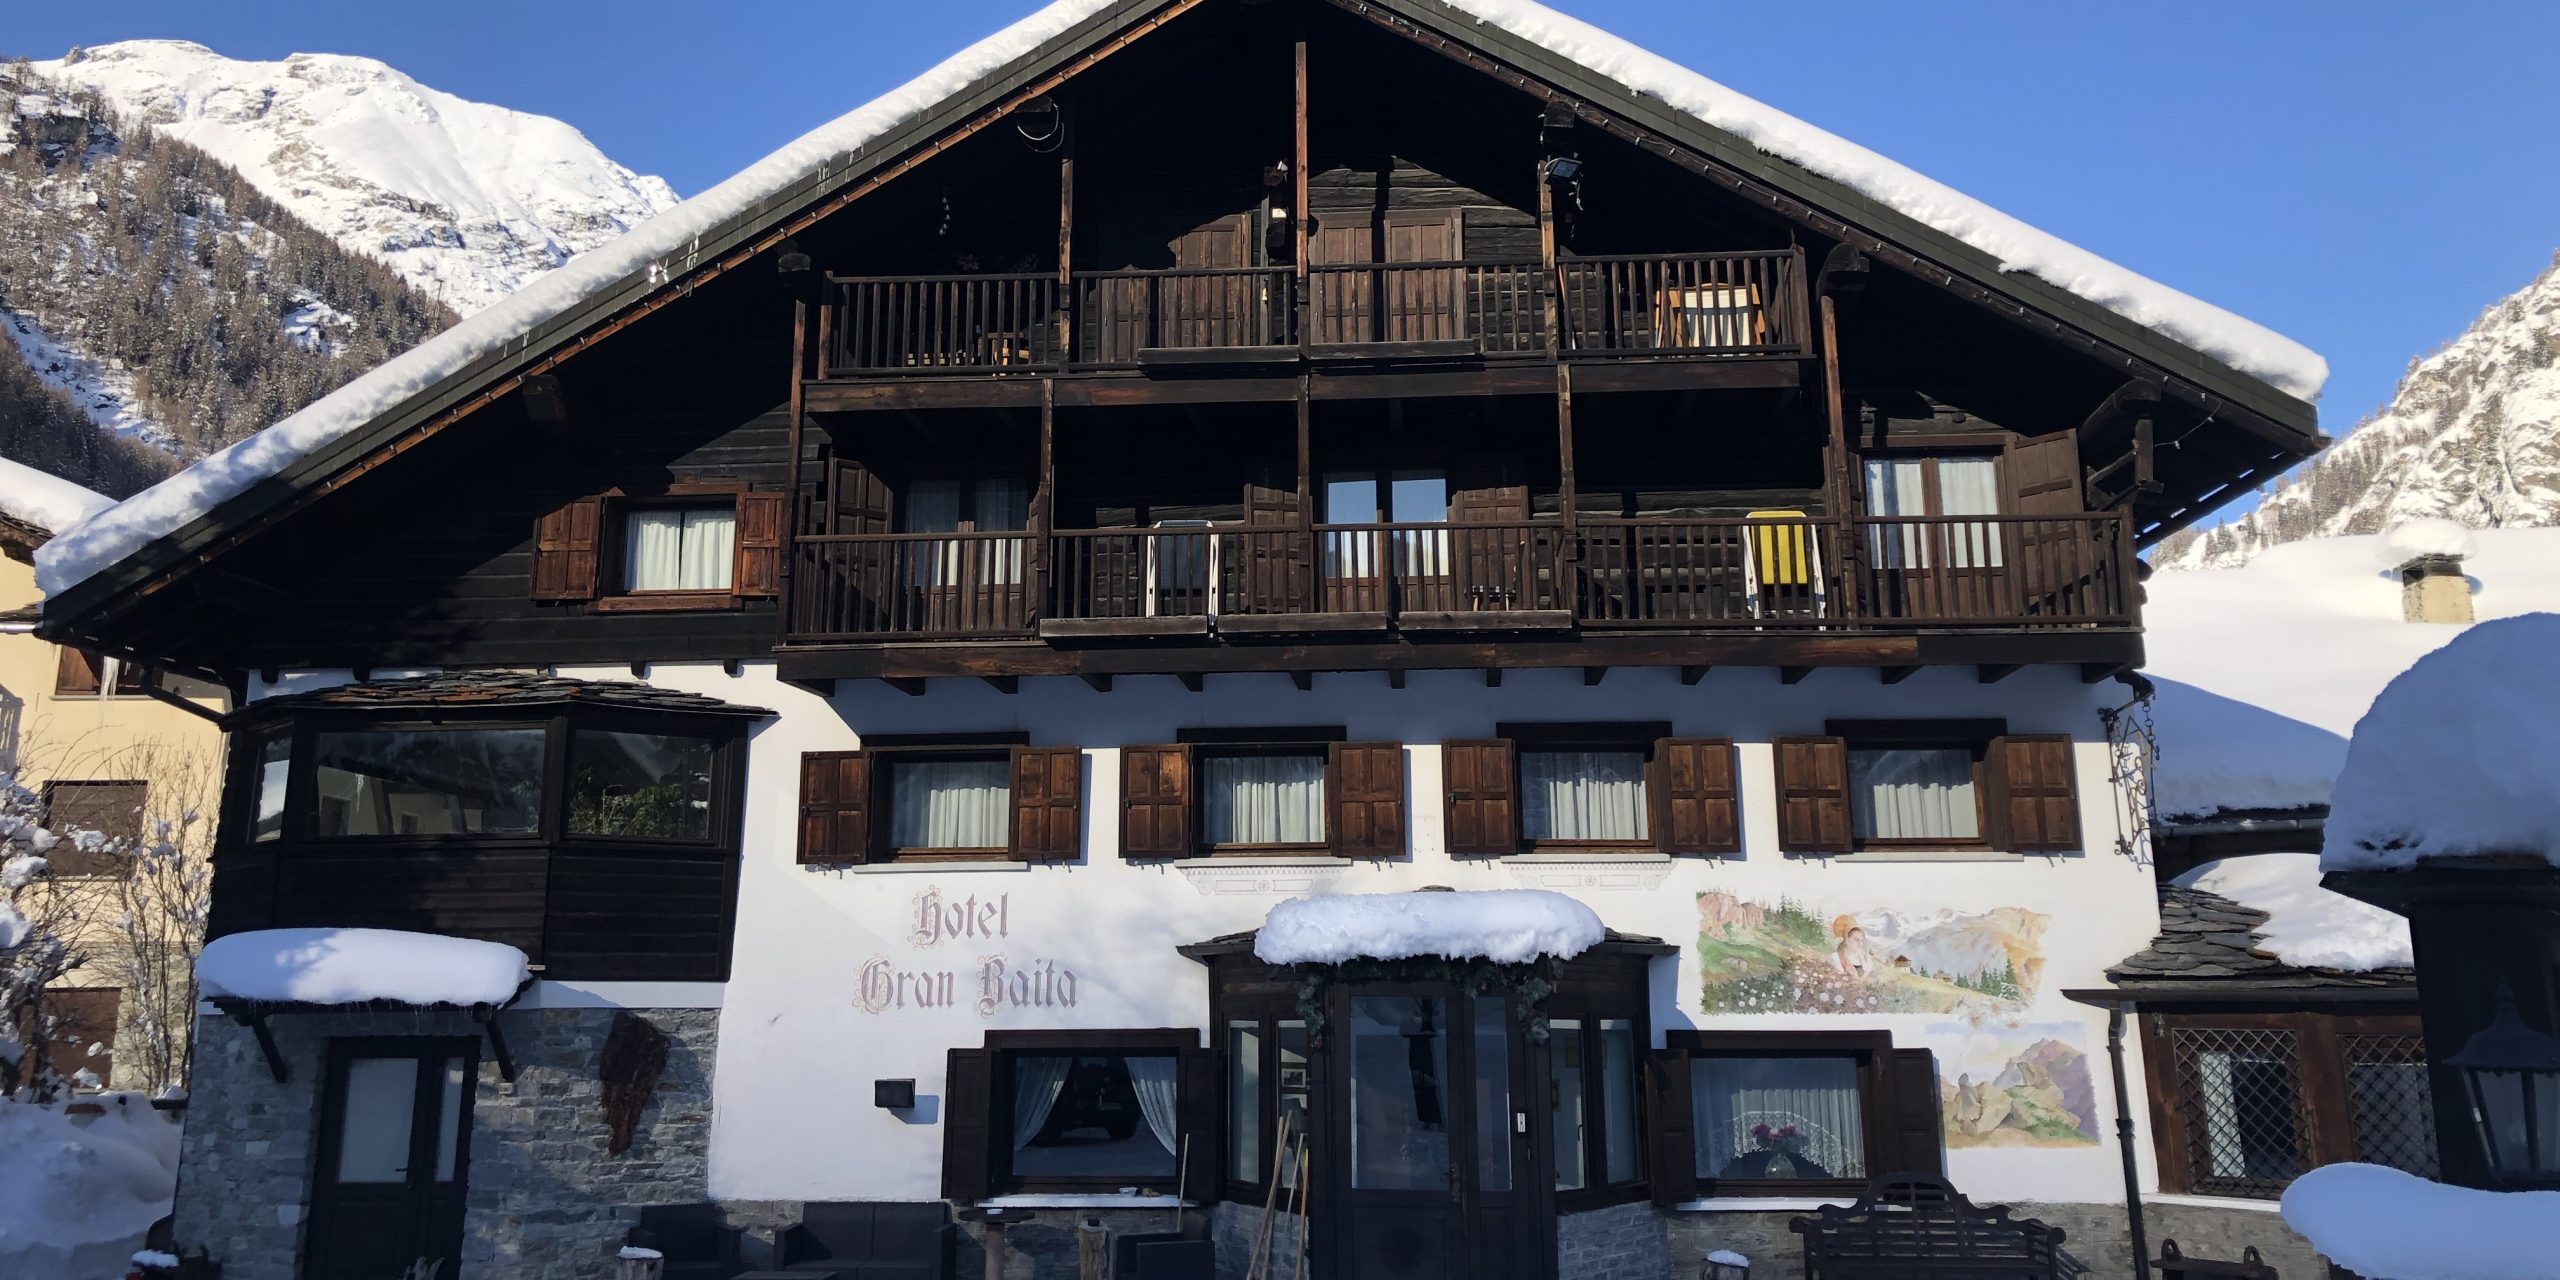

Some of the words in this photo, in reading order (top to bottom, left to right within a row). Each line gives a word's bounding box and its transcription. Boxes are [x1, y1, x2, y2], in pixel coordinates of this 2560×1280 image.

[909, 886, 1009, 948] Hotel
[853, 954, 955, 1014] Gran
[976, 953, 1078, 1017] Baita
